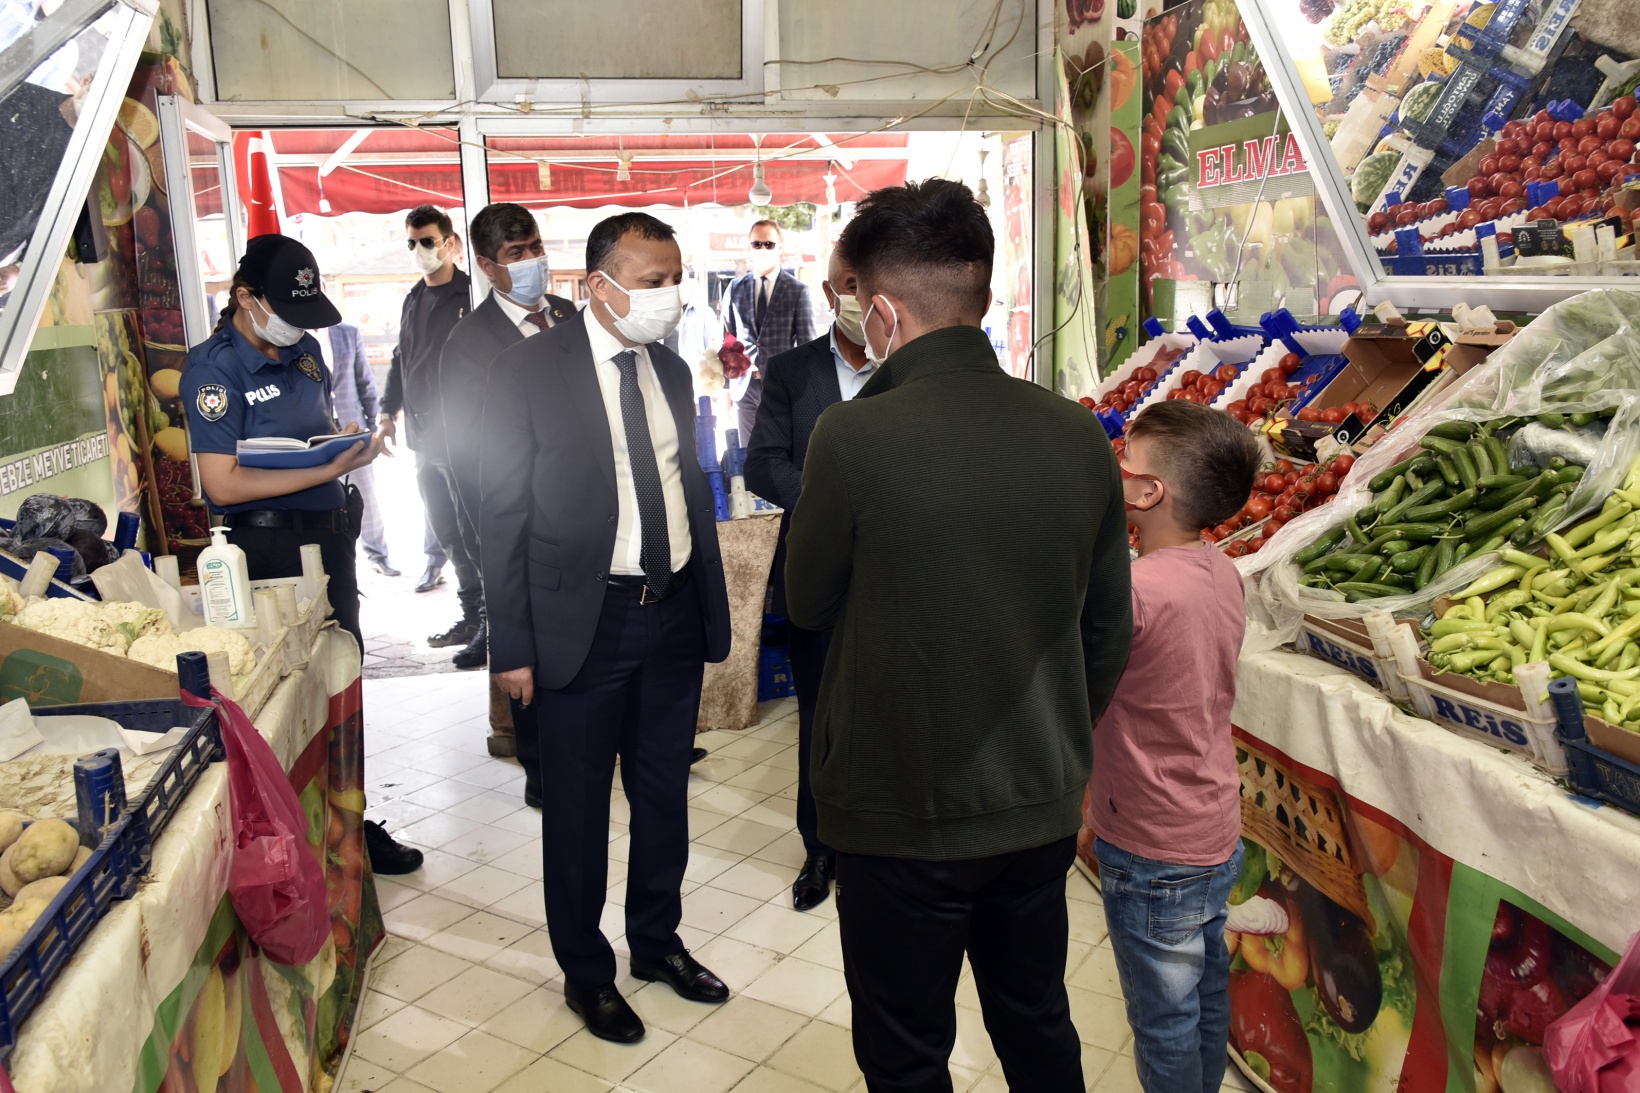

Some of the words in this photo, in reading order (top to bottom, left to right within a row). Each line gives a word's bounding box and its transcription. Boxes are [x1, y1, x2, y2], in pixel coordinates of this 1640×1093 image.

[1196, 131, 1309, 189] ELMA
[0, 457, 33, 496] EBZE
[32, 443, 72, 482] MEYVE
